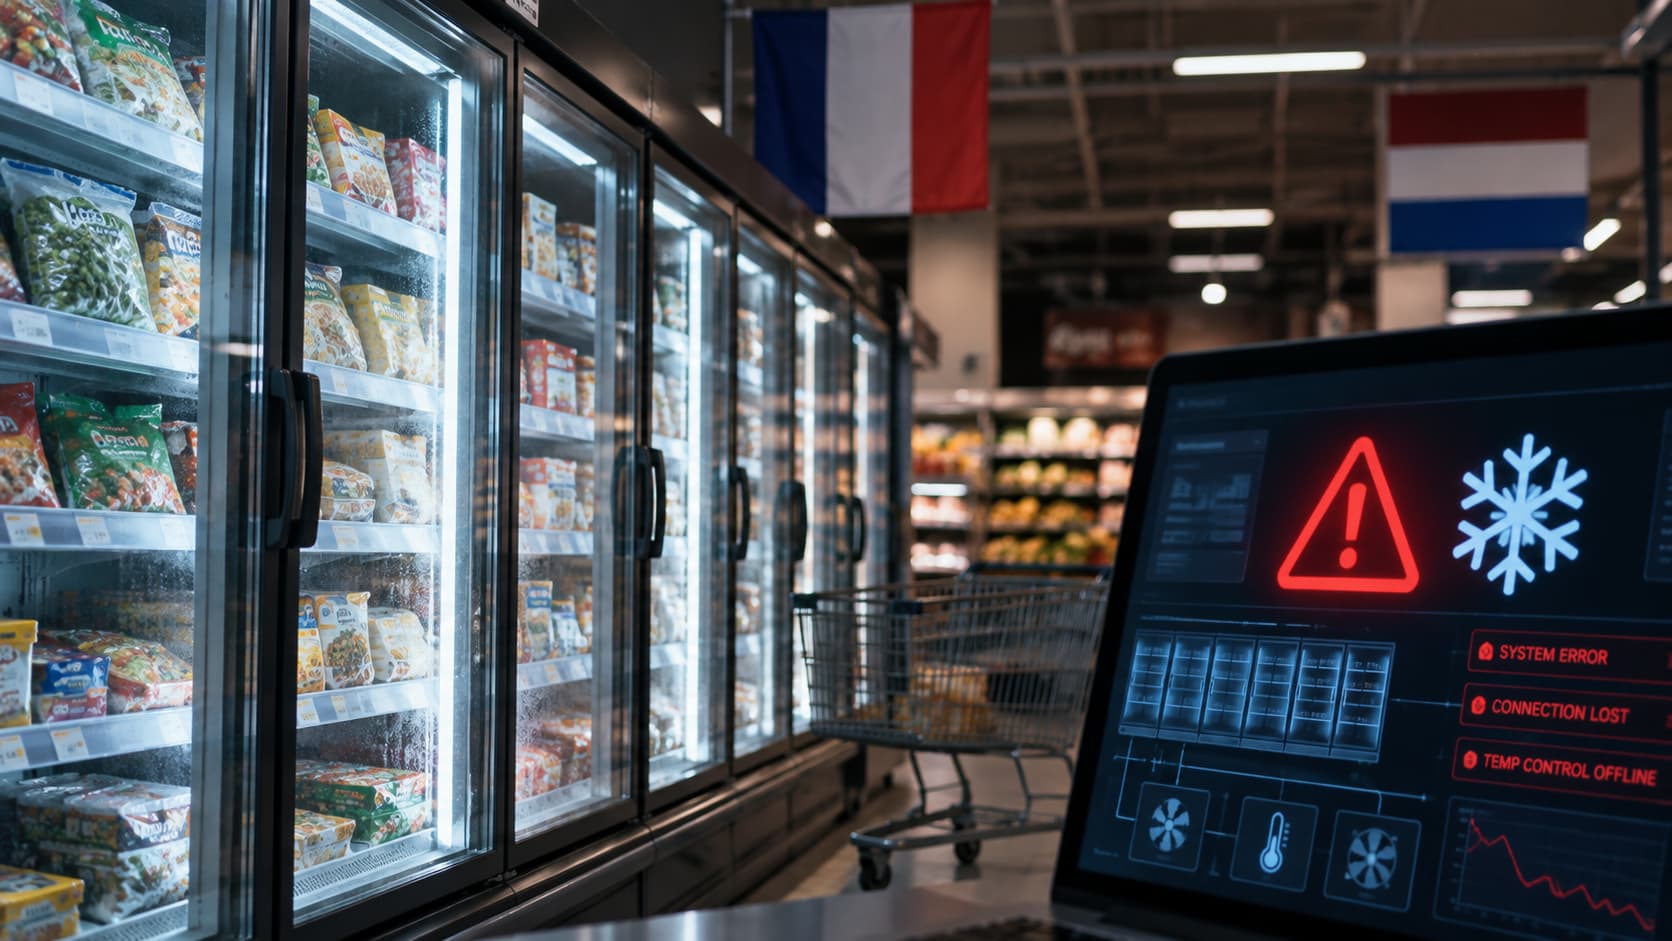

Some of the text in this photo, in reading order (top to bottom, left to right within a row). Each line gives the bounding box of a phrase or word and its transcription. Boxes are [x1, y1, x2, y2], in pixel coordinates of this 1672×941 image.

[1500, 645, 1608, 664] SYSTEM ERROR
[1492, 699, 1629, 723] CONNECTION LOST
[1484, 754, 1656, 786] TEMP CONTROL OFFLINE
